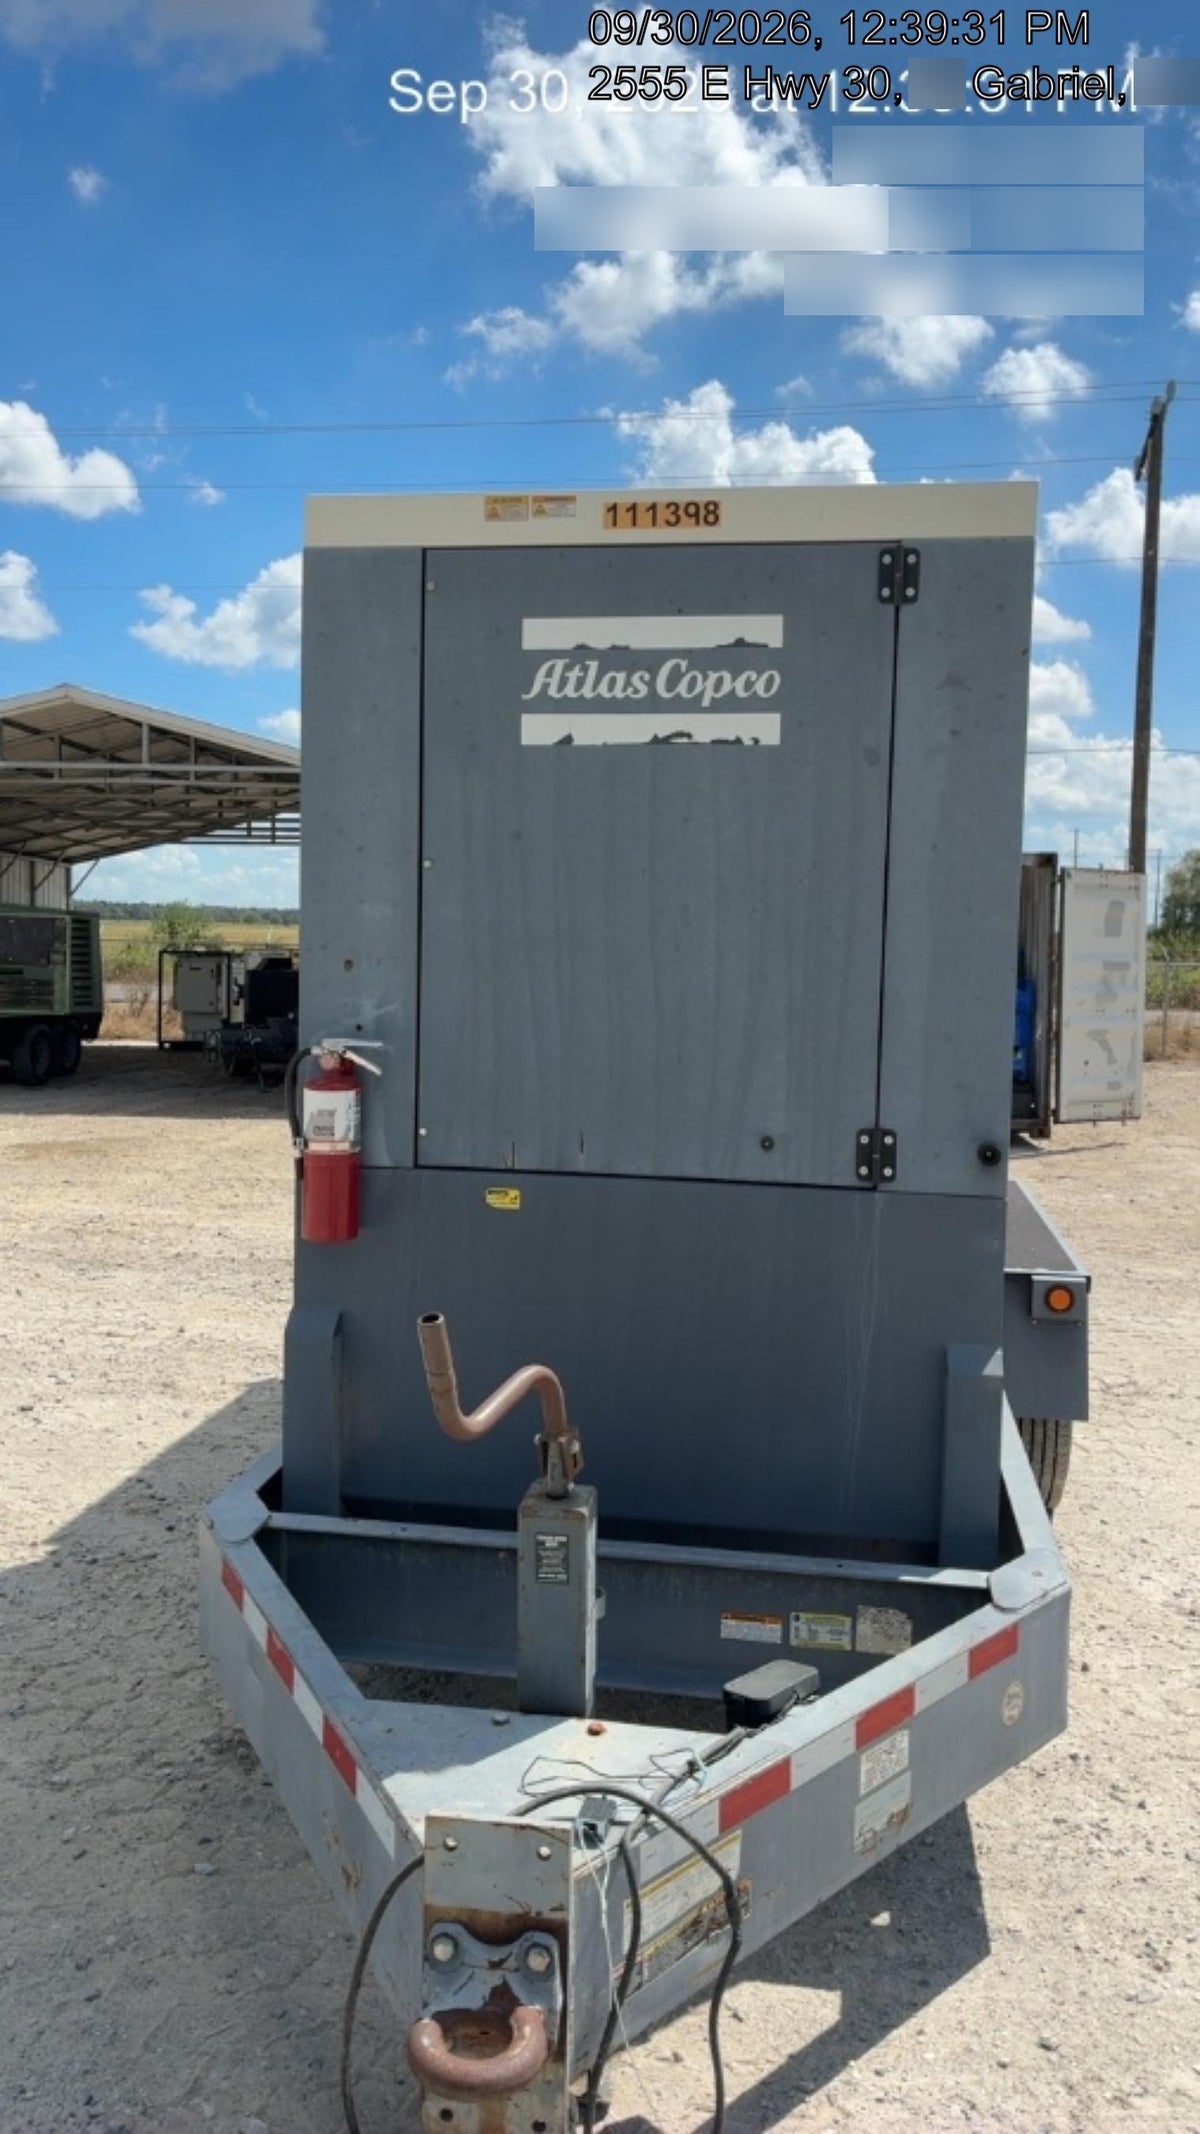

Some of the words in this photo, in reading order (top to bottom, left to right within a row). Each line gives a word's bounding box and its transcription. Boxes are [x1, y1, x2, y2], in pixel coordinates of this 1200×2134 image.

[606, 500, 720, 527] 111398
[521, 658, 651, 700] Atlas
[655, 658, 782, 707] Copco
